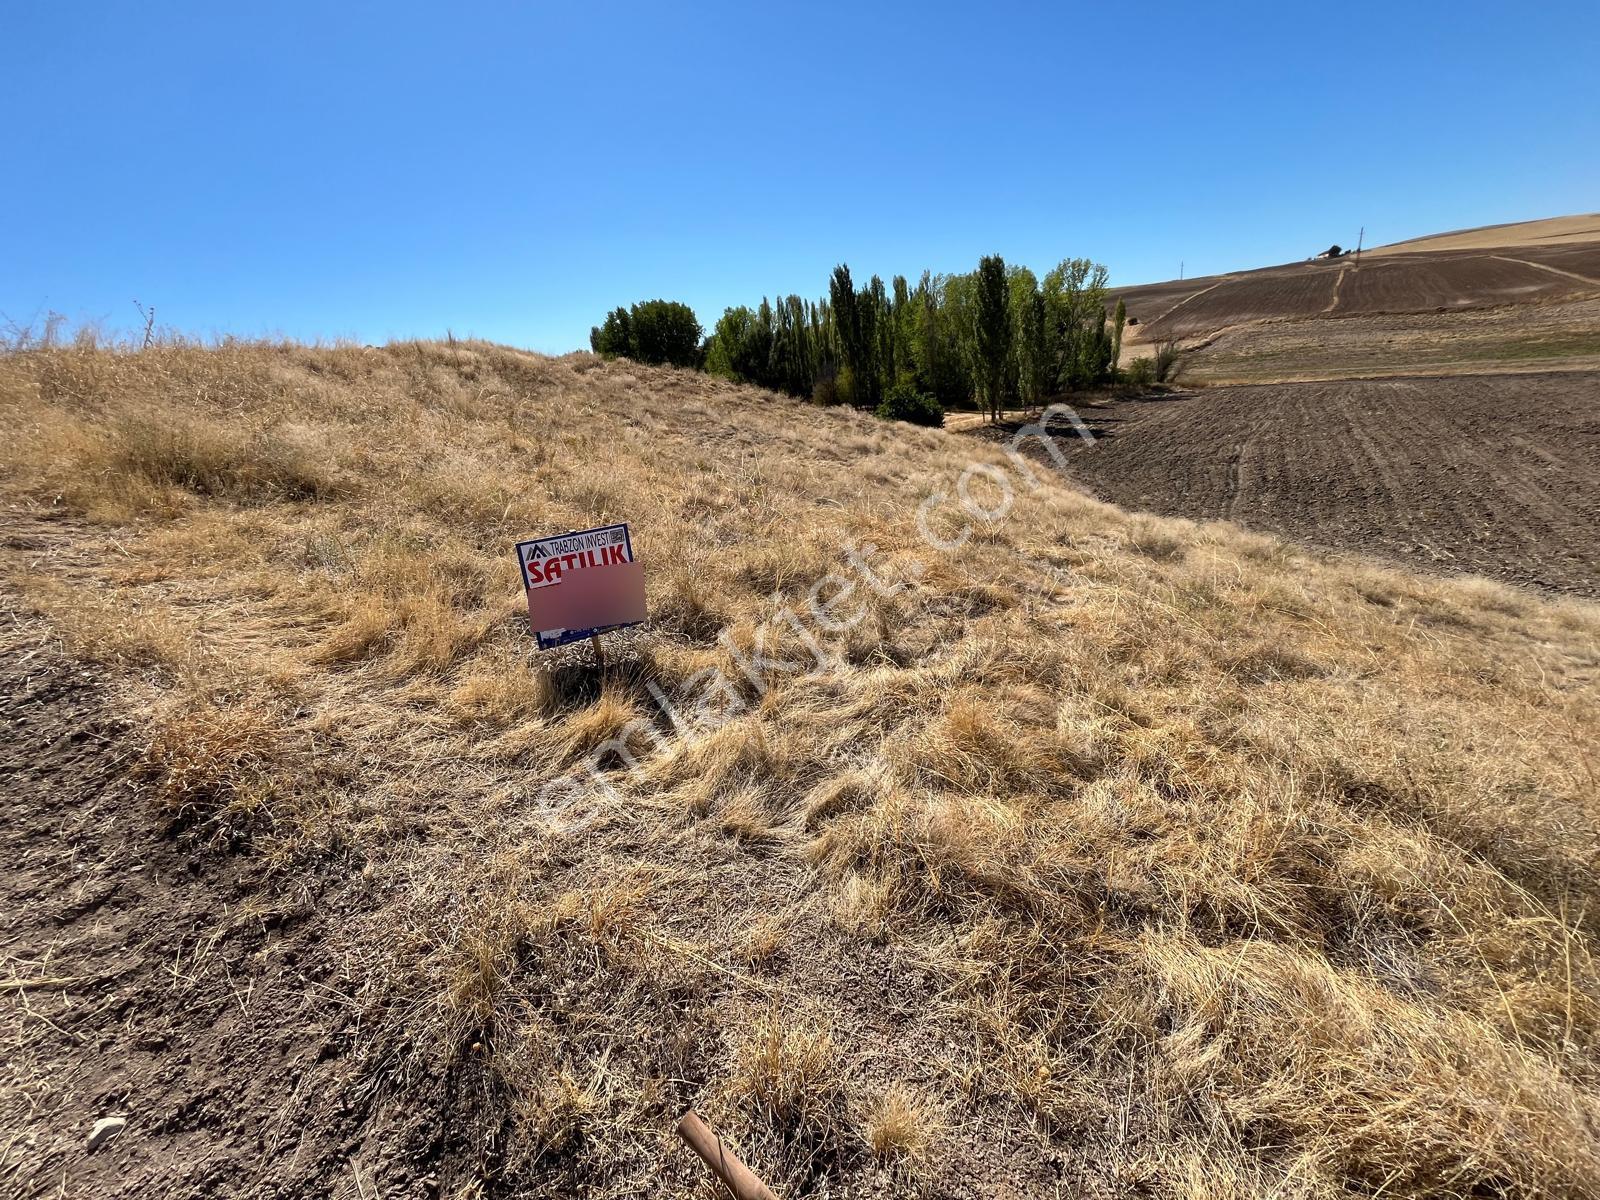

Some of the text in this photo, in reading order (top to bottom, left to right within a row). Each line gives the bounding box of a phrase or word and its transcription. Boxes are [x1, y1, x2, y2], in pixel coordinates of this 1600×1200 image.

[550, 531, 610, 556] TRABZON INVEST
[527, 544, 628, 583] SATILIK
